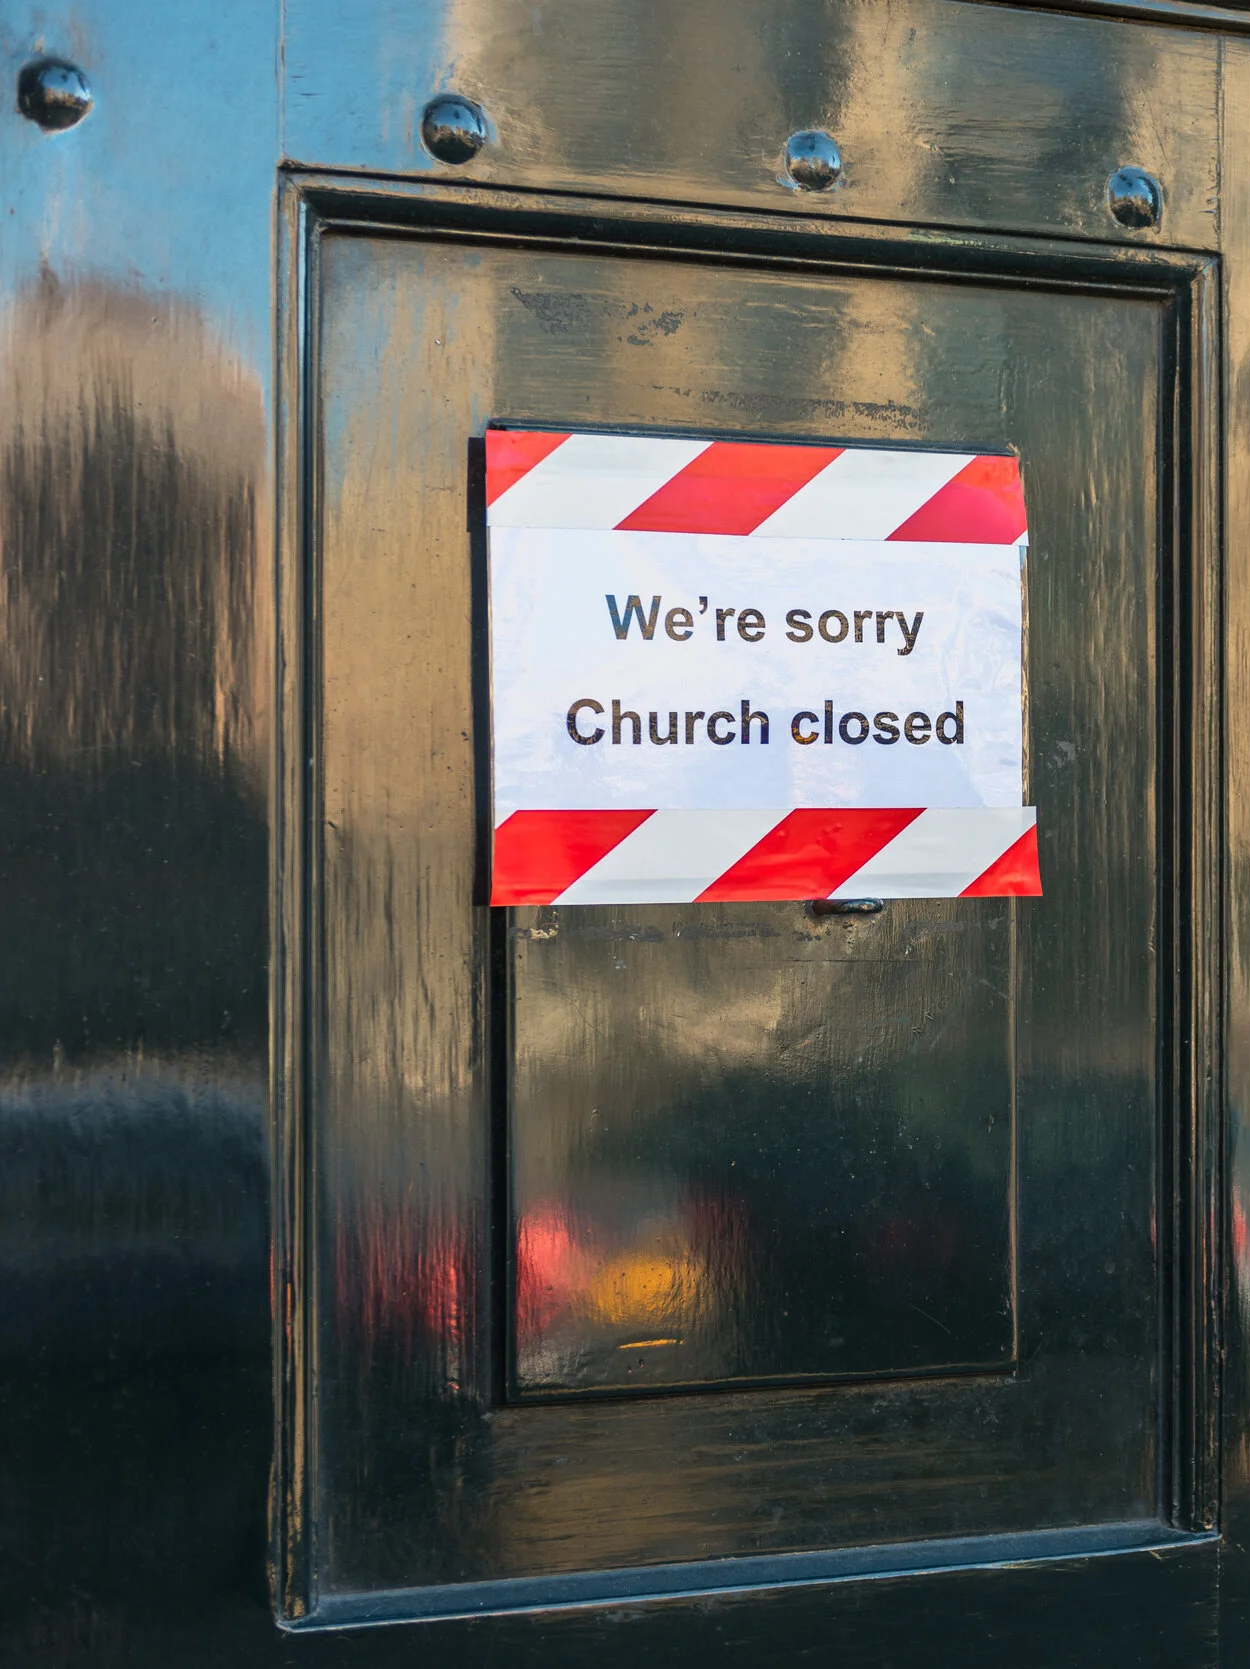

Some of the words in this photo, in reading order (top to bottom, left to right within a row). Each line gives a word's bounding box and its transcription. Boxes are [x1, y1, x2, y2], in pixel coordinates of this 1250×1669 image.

[784, 608, 924, 657] sorry
[566, 697, 770, 747] Church
[790, 698, 965, 747] closed
